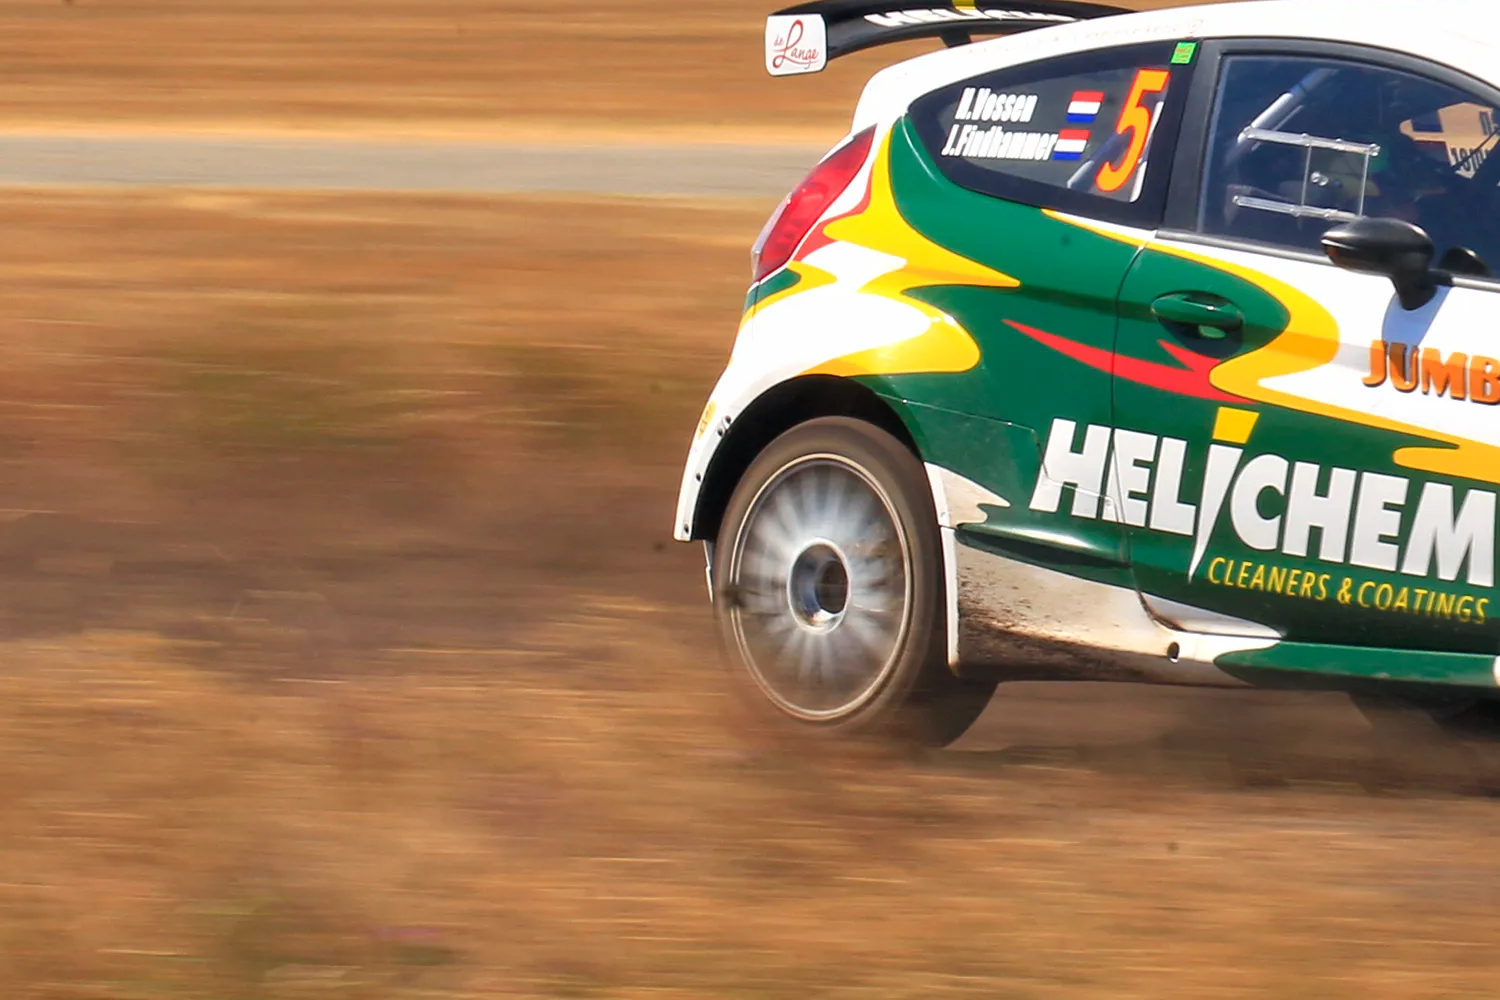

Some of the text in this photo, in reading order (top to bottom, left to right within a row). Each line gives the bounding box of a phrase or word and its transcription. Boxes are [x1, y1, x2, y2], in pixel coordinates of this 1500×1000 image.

[1095, 68, 1171, 193] 5
[1028, 406, 1498, 588] HELICHEM
[1208, 556, 1329, 602] CLEANERS
[1357, 580, 1490, 625] COATINGS
